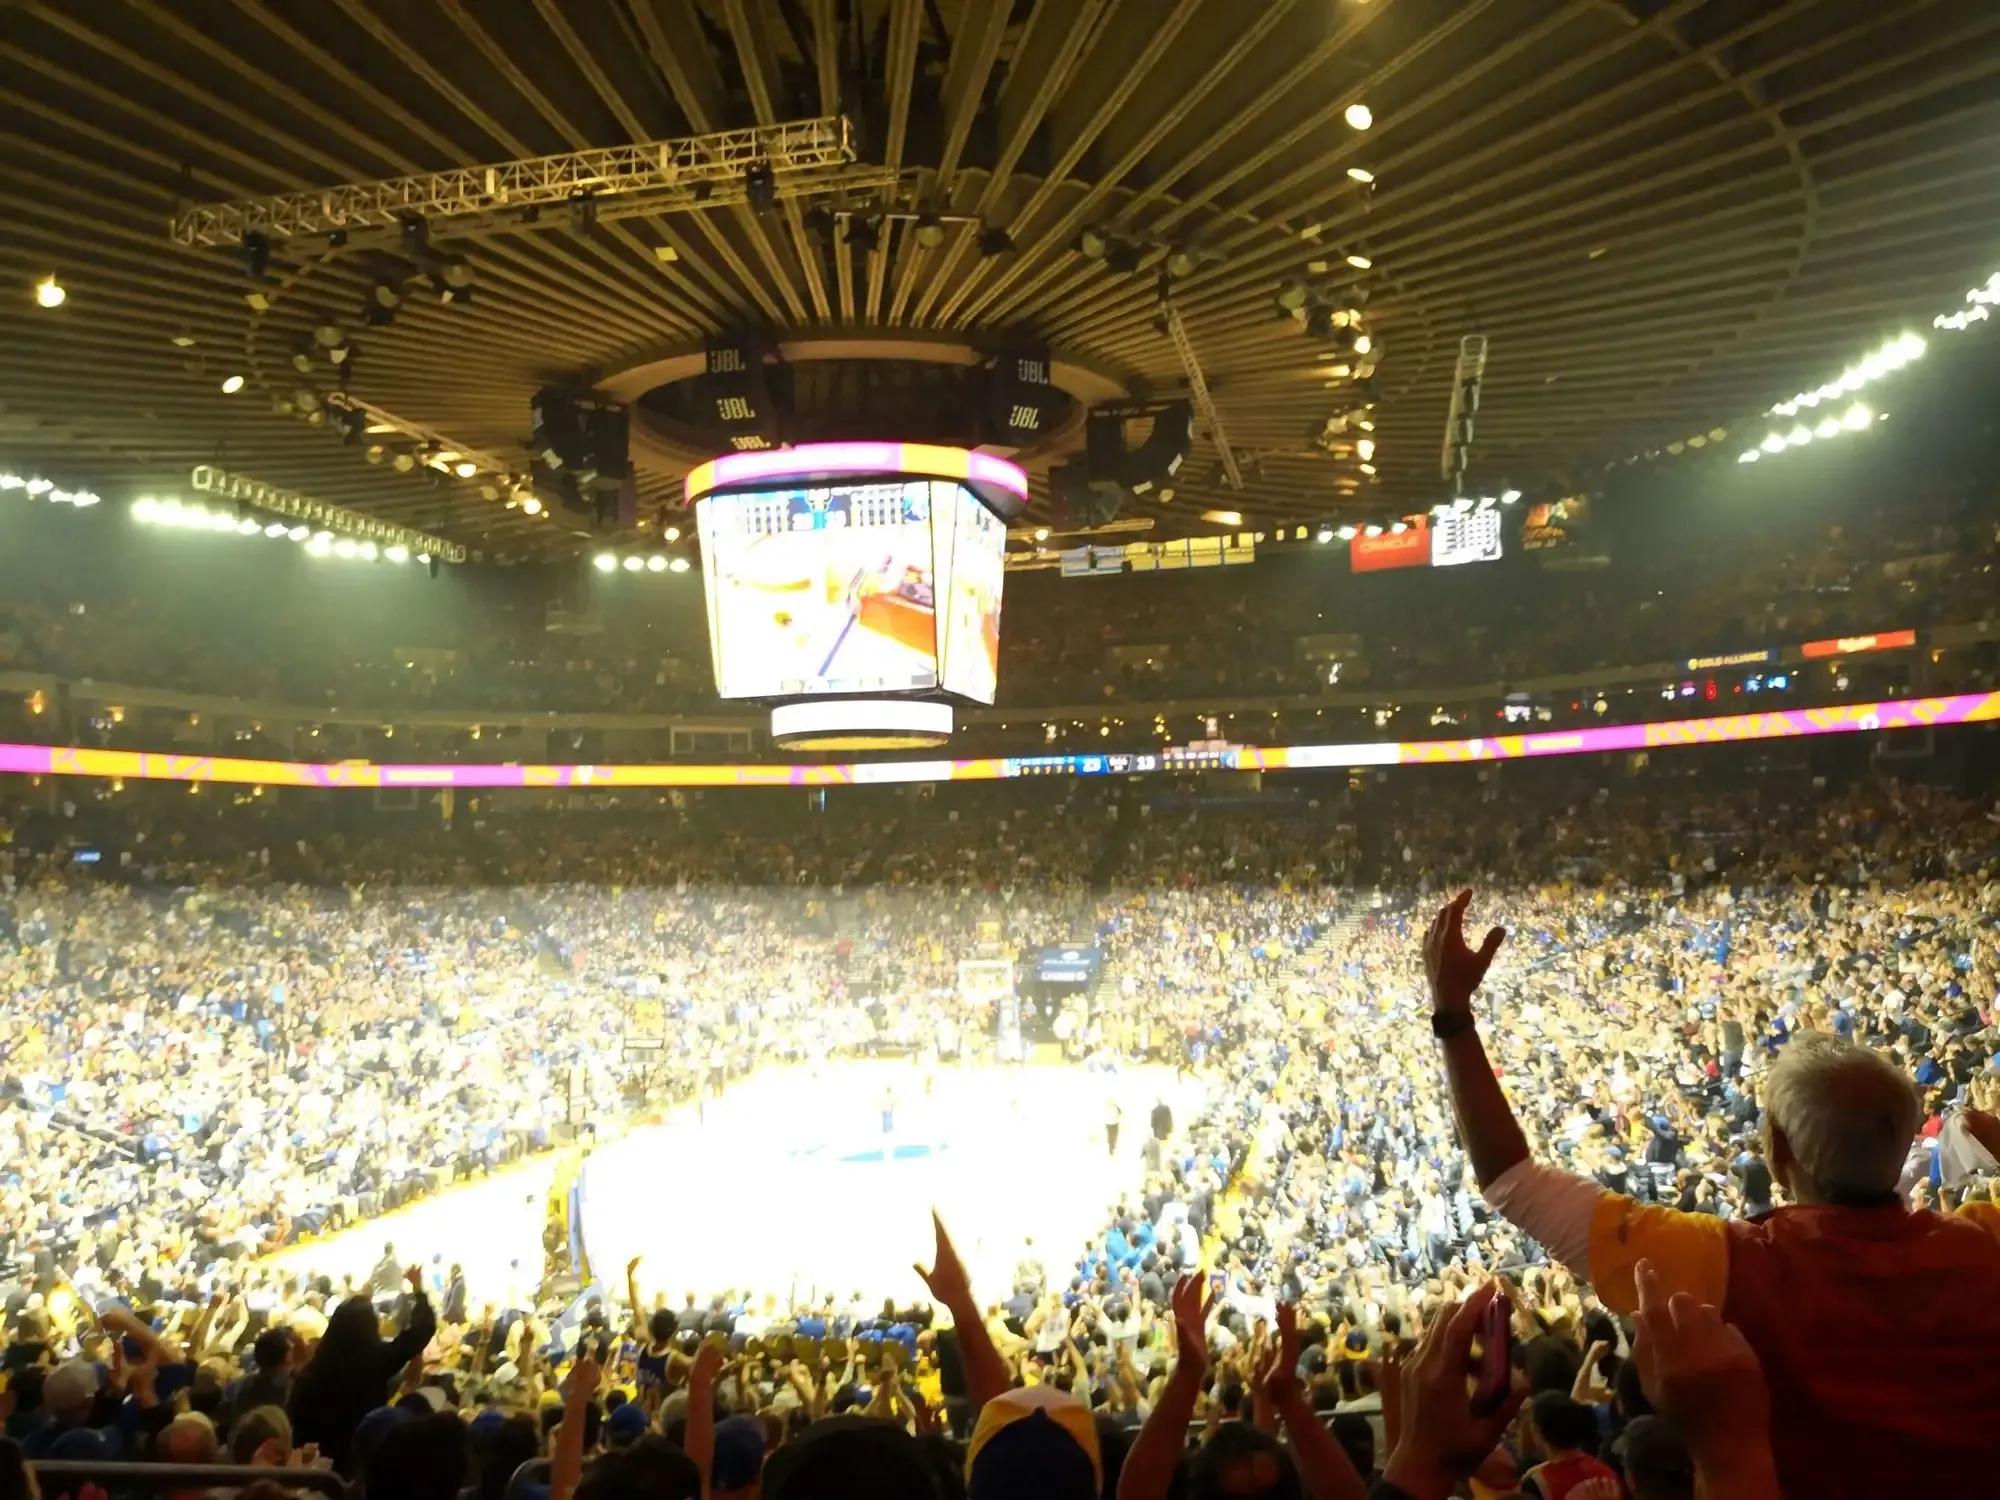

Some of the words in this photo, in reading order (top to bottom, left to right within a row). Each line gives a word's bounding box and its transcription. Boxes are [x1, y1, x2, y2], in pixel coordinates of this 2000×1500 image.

[710, 349, 746, 373] JBL
[1018, 358, 1048, 384] JBL
[716, 397, 755, 420] JBL
[1009, 405, 1039, 430] JBL
[730, 435, 771, 451] JBL
